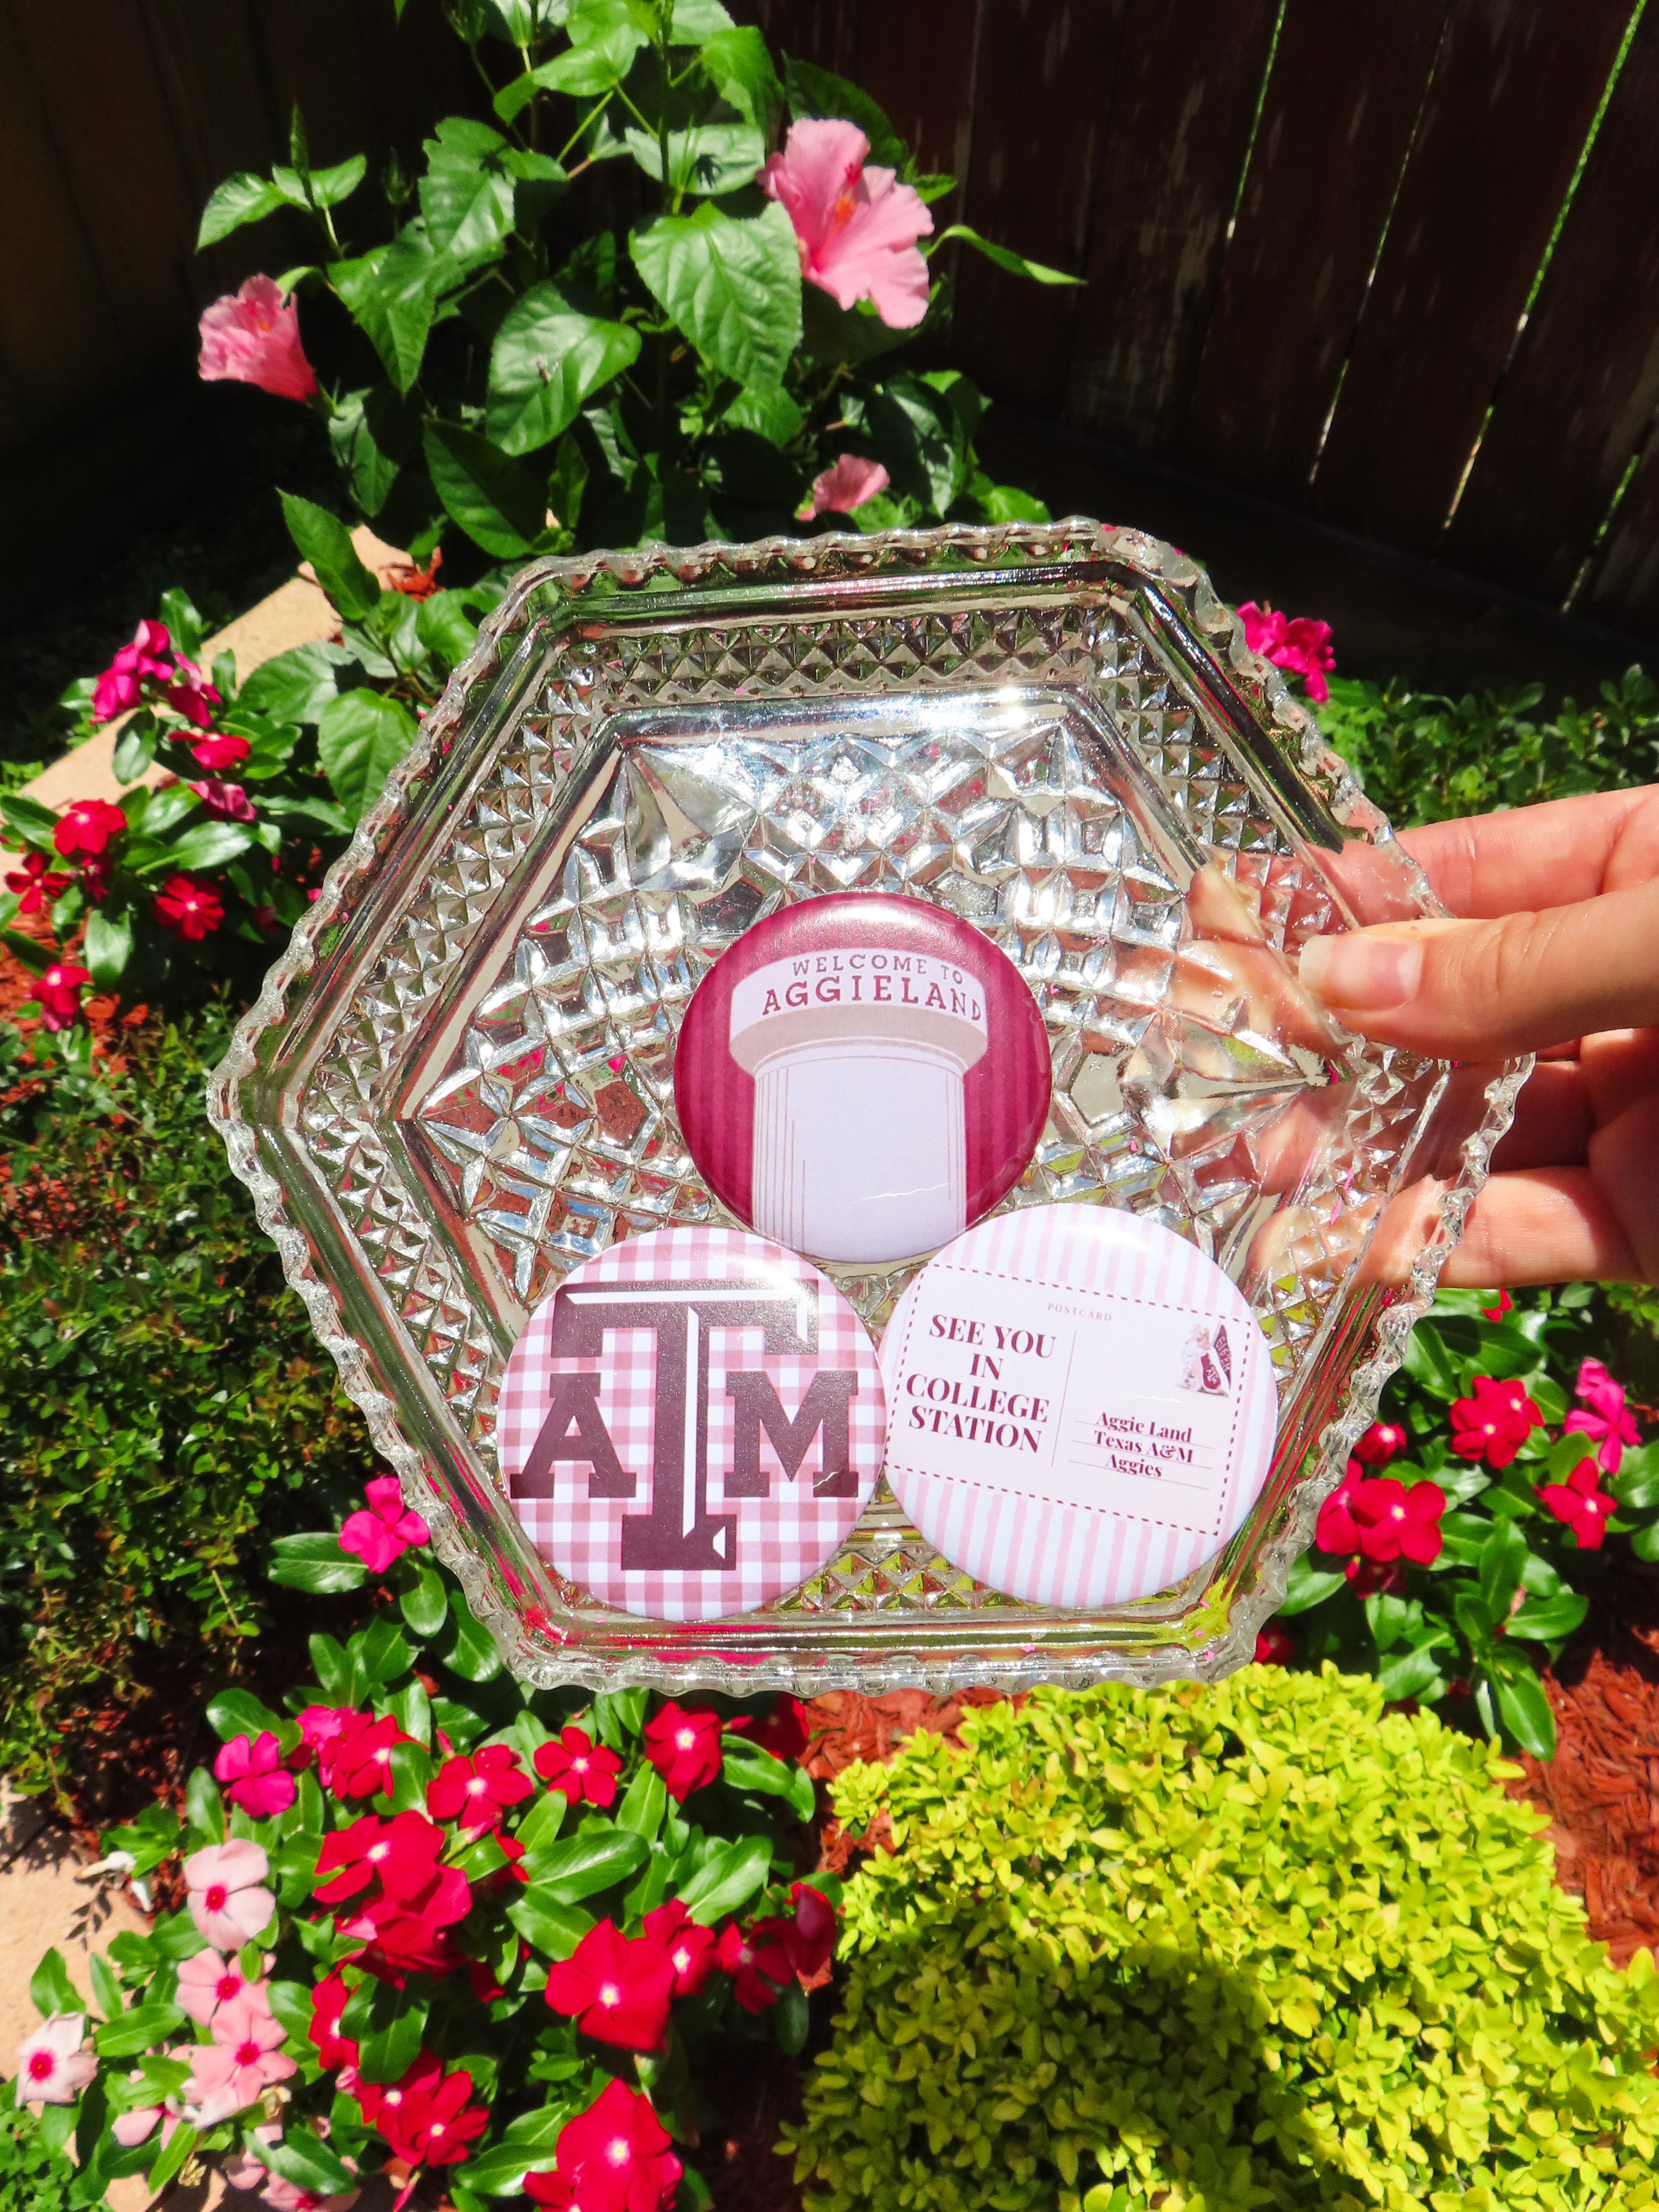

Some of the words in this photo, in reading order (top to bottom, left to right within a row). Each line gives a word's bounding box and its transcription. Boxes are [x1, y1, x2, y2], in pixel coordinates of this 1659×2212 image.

[793, 954, 927, 976] WELCOME
[941, 964, 963, 984] TO
[762, 975, 981, 1021] AGGIELAND
[1047, 1302, 1112, 1321] POSTCARD
[929, 1314, 986, 1346] SEE
[994, 1325, 1057, 1359] YOU
[969, 1353, 1005, 1381] IN
[906, 1373, 1050, 1423] COLLEGE
[908, 1405, 1043, 1454] STATION
[1096, 1412, 1145, 1433] Aggie
[1149, 1421, 1192, 1443] Land
[1094, 1430, 1142, 1453] Texas
[1146, 1442, 1193, 1463] A&M
[1105, 1454, 1163, 1478] Aggies
